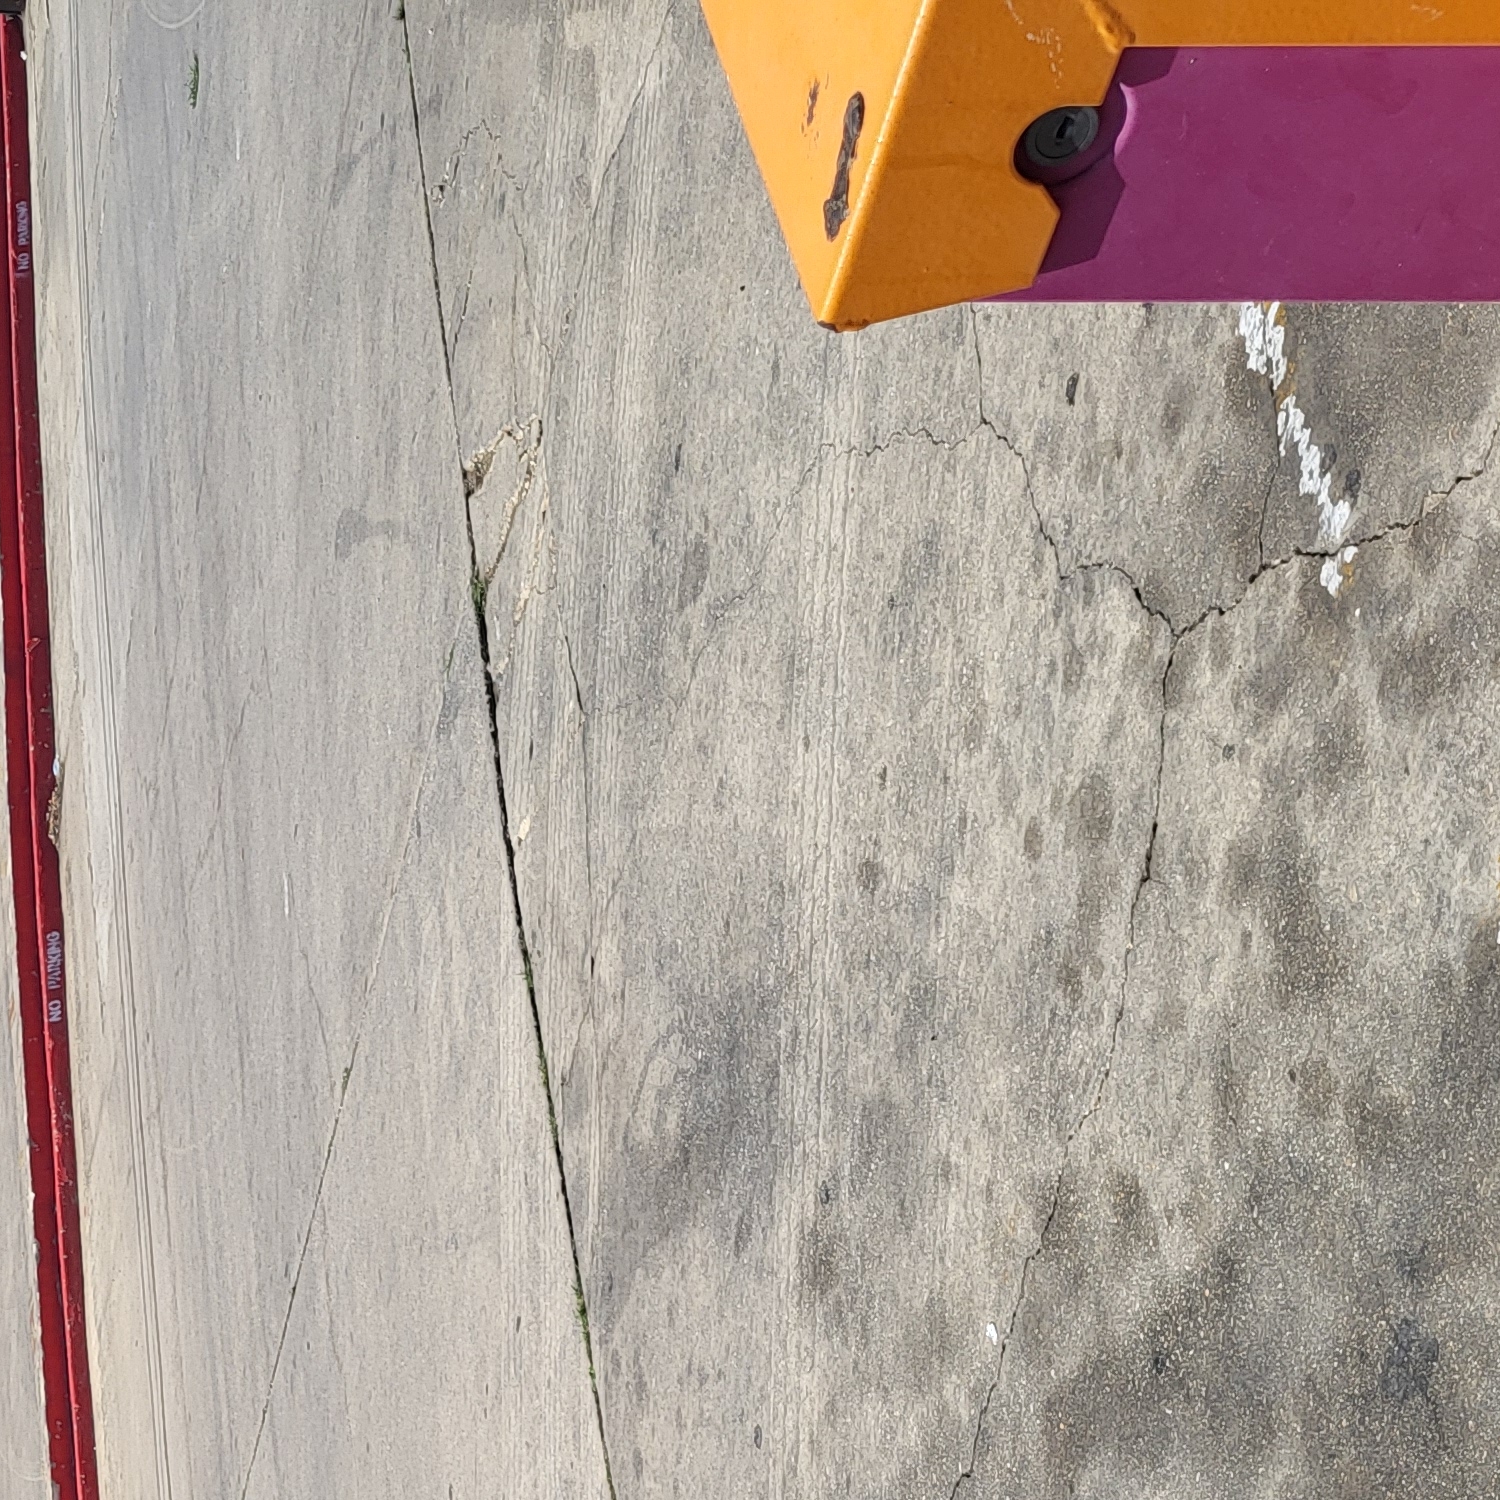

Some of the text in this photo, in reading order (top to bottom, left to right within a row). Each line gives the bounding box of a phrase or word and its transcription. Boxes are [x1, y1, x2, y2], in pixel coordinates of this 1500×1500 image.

[17, 252, 30, 270] NO
[46, 930, 62, 1023] NO PARKING
